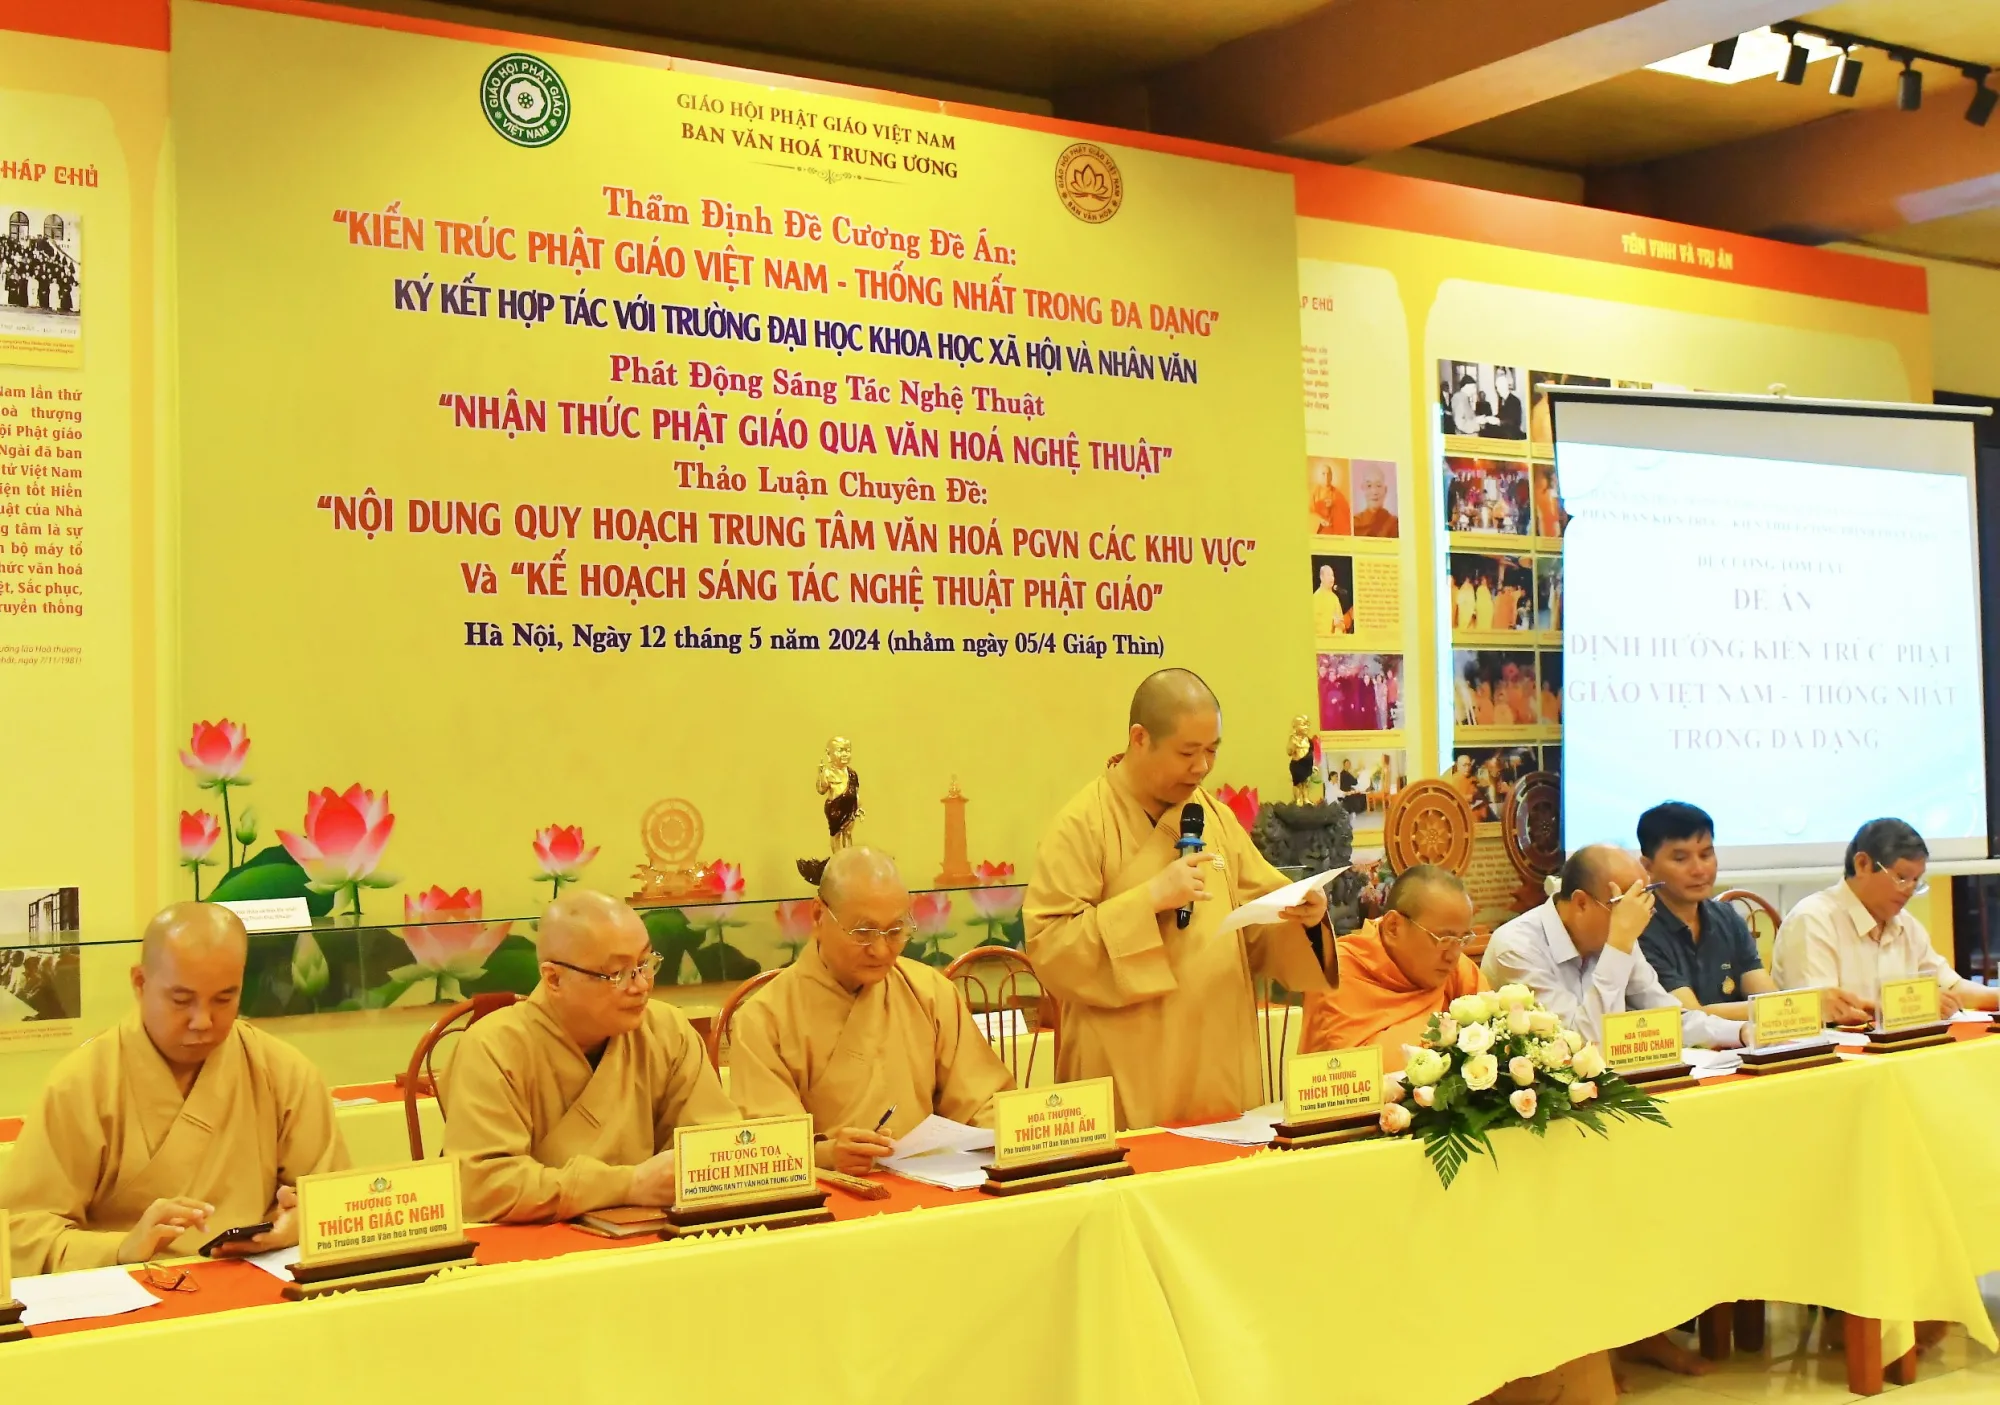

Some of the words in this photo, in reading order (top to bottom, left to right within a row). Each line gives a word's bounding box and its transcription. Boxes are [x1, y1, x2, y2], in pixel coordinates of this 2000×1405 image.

[487, 77, 501, 108] GIÁO
[498, 62, 518, 80] HỘI
[549, 86, 564, 117] GIÁO
[503, 119, 524, 137] VIỆT
[526, 125, 550, 139] NAM
[677, 94, 724, 113] GIÁO
[731, 101, 763, 122] HỘI
[771, 108, 817, 129] PHẬT
[823, 117, 867, 135] GIÁO
[873, 124, 912, 145] VIỆT
[917, 131, 955, 150] NAM
[682, 123, 724, 144] BAN
[732, 129, 773, 151] VĂN
[780, 137, 822, 158] HOÁ
[829, 142, 898, 169] TRUNG
[903, 155, 957, 178] ƯƠNG
[54, 164, 98, 187] CHỦ
[603, 186, 689, 224] Thẩm
[701, 199, 773, 237] Định
[784, 210, 821, 241] Đề
[833, 216, 920, 259] Cương
[929, 229, 964, 259] Đề
[973, 228, 1016, 265] Án:
[333, 202, 423, 251] “KIẾN
[435, 216, 516, 260] TRÚC
[529, 227, 604, 276] PHẬT
[615, 236, 685, 278] GIÁO
[694, 245, 754, 292] VIỆT
[765, 258, 828, 294] NAM
[855, 260, 943, 306] THỐNG
[953, 273, 1016, 314] NHẤT
[1023, 289, 1102, 324] TRONG
[1111, 300, 1142, 329] ĐA
[1150, 304, 1219, 339] DẠNG”
[395, 272, 434, 311] KÝ
[441, 272, 491, 317] KẾT
[498, 289, 555, 328] HỢP
[560, 288, 608, 327] TÁC
[613, 294, 655, 332] VỚI
[661, 301, 760, 342] TRƯỜNG
[767, 316, 806, 352] ĐẠI
[814, 320, 863, 356] HỌC
[869, 326, 933, 358] KHOA
[938, 333, 984, 368] HỌC
[989, 334, 1021, 367] XÃ
[1026, 336, 1062, 376] HỘI
[1066, 340, 1094, 374] VÀ
[1099, 346, 1154, 380] NHÂN
[1158, 352, 1197, 384] VĂN
[31, 384, 52, 399] lần
[58, 389, 82, 401] thứ
[610, 355, 678, 386] Phát
[689, 362, 763, 399] Động
[773, 368, 837, 404] Sáng
[846, 375, 890, 403] Tác
[900, 380, 963, 415] Nghệ
[972, 386, 1045, 421] Thuật
[31, 406, 82, 423] thượng
[16, 425, 48, 440] Phật
[52, 427, 82, 441] giáo
[439, 388, 545, 439] “NHẬN
[558, 396, 640, 438] THỨC
[653, 402, 728, 450] PHẬT
[739, 408, 808, 449] GIÁO
[820, 421, 877, 454] QUA
[885, 421, 938, 458] VĂN
[950, 425, 1004, 462] HOÁ
[1014, 432, 1080, 475] NGHỆ
[1088, 437, 1172, 479] THUẬT”
[0, 444, 30, 458] Ngài
[35, 445, 52, 458] đã
[56, 446, 82, 459] ban
[21, 464, 48, 479] Việt
[51, 466, 82, 478] Nam
[51, 483, 82, 497] Hiến
[56, 505, 82, 517] Nhà
[15, 523, 42, 535] tâm
[48, 524, 60, 536] là
[66, 527, 83, 539] sự
[317, 487, 392, 540] “NỘI
[409, 500, 500, 536] DUNG
[515, 504, 581, 540] QUY
[594, 508, 697, 549] HOẠCH
[709, 513, 805, 547] TRUNG
[815, 510, 875, 550] TÂM
[884, 516, 937, 553] VĂN
[949, 518, 1003, 555] HOÁ
[1013, 528, 1079, 559] PGVN
[1089, 525, 1136, 561] CÁC
[1146, 535, 1192, 564] KHU
[1201, 537, 1255, 572] VỰC”
[11, 542, 28, 557] bộ
[34, 543, 63, 557] máy
[70, 541, 83, 556] tổ
[18, 579, 41, 594] Sắc
[45, 582, 82, 597] phục,
[464, 622, 504, 646] Hà
[512, 623, 563, 652] Nội,
[572, 624, 632, 653] Ngày
[640, 625, 666, 647] 12
[674, 626, 742, 654] tháng
[749, 626, 762, 649] 5
[770, 628, 820, 650] năm
[829, 628, 880, 650] 2024
[963, 632, 1009, 657] ngày
[1015, 632, 1056, 654] 05/4
[1063, 633, 1107, 659] Giáp
[1112, 634, 1164, 659] Thìn)
[1299, 1086, 1328, 1101] THÍCH
[1331, 1083, 1349, 1097] THỌ
[1353, 1080, 1371, 1095] LẠC
[1015, 1125, 1050, 1142] THÍCH
[710, 1148, 757, 1163] THƯỢNG
[688, 1165, 730, 1183] THÍCH
[734, 1162, 769, 1178] MINH
[772, 1153, 803, 1172] HIỀN
[345, 1196, 392, 1212] THƯỢNG
[319, 1216, 364, 1237] THÍCH
[369, 1209, 404, 1230] GIÁC
[409, 1204, 445, 1223] NGHI
[362, 1235, 376, 1243] Ban
